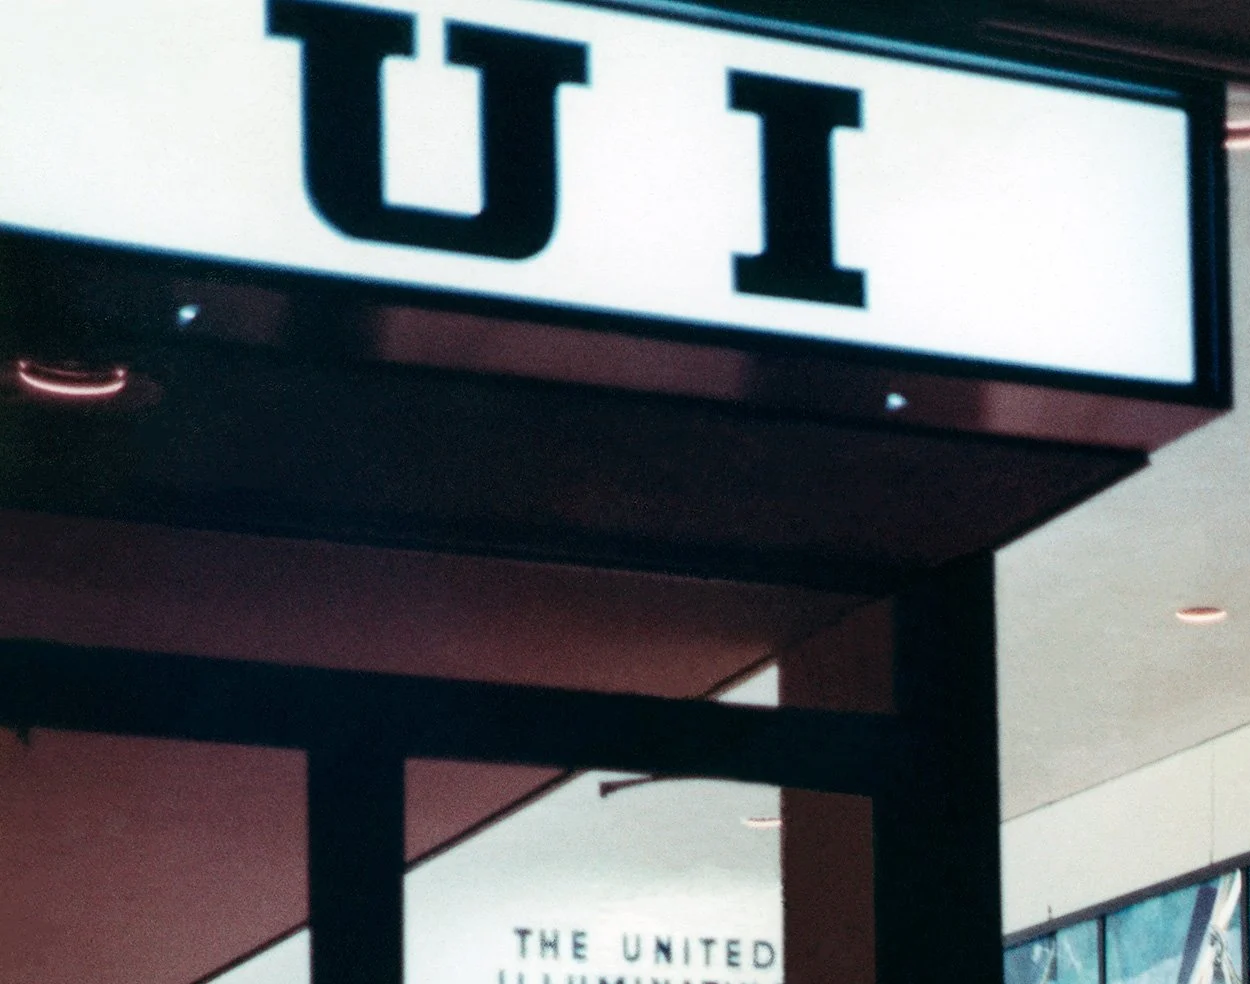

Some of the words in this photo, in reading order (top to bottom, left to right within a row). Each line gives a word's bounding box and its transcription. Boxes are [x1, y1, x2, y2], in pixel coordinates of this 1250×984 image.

[263, 0, 868, 310] UI
[513, 928, 589, 961] THE
[621, 933, 777, 969] UNITED
